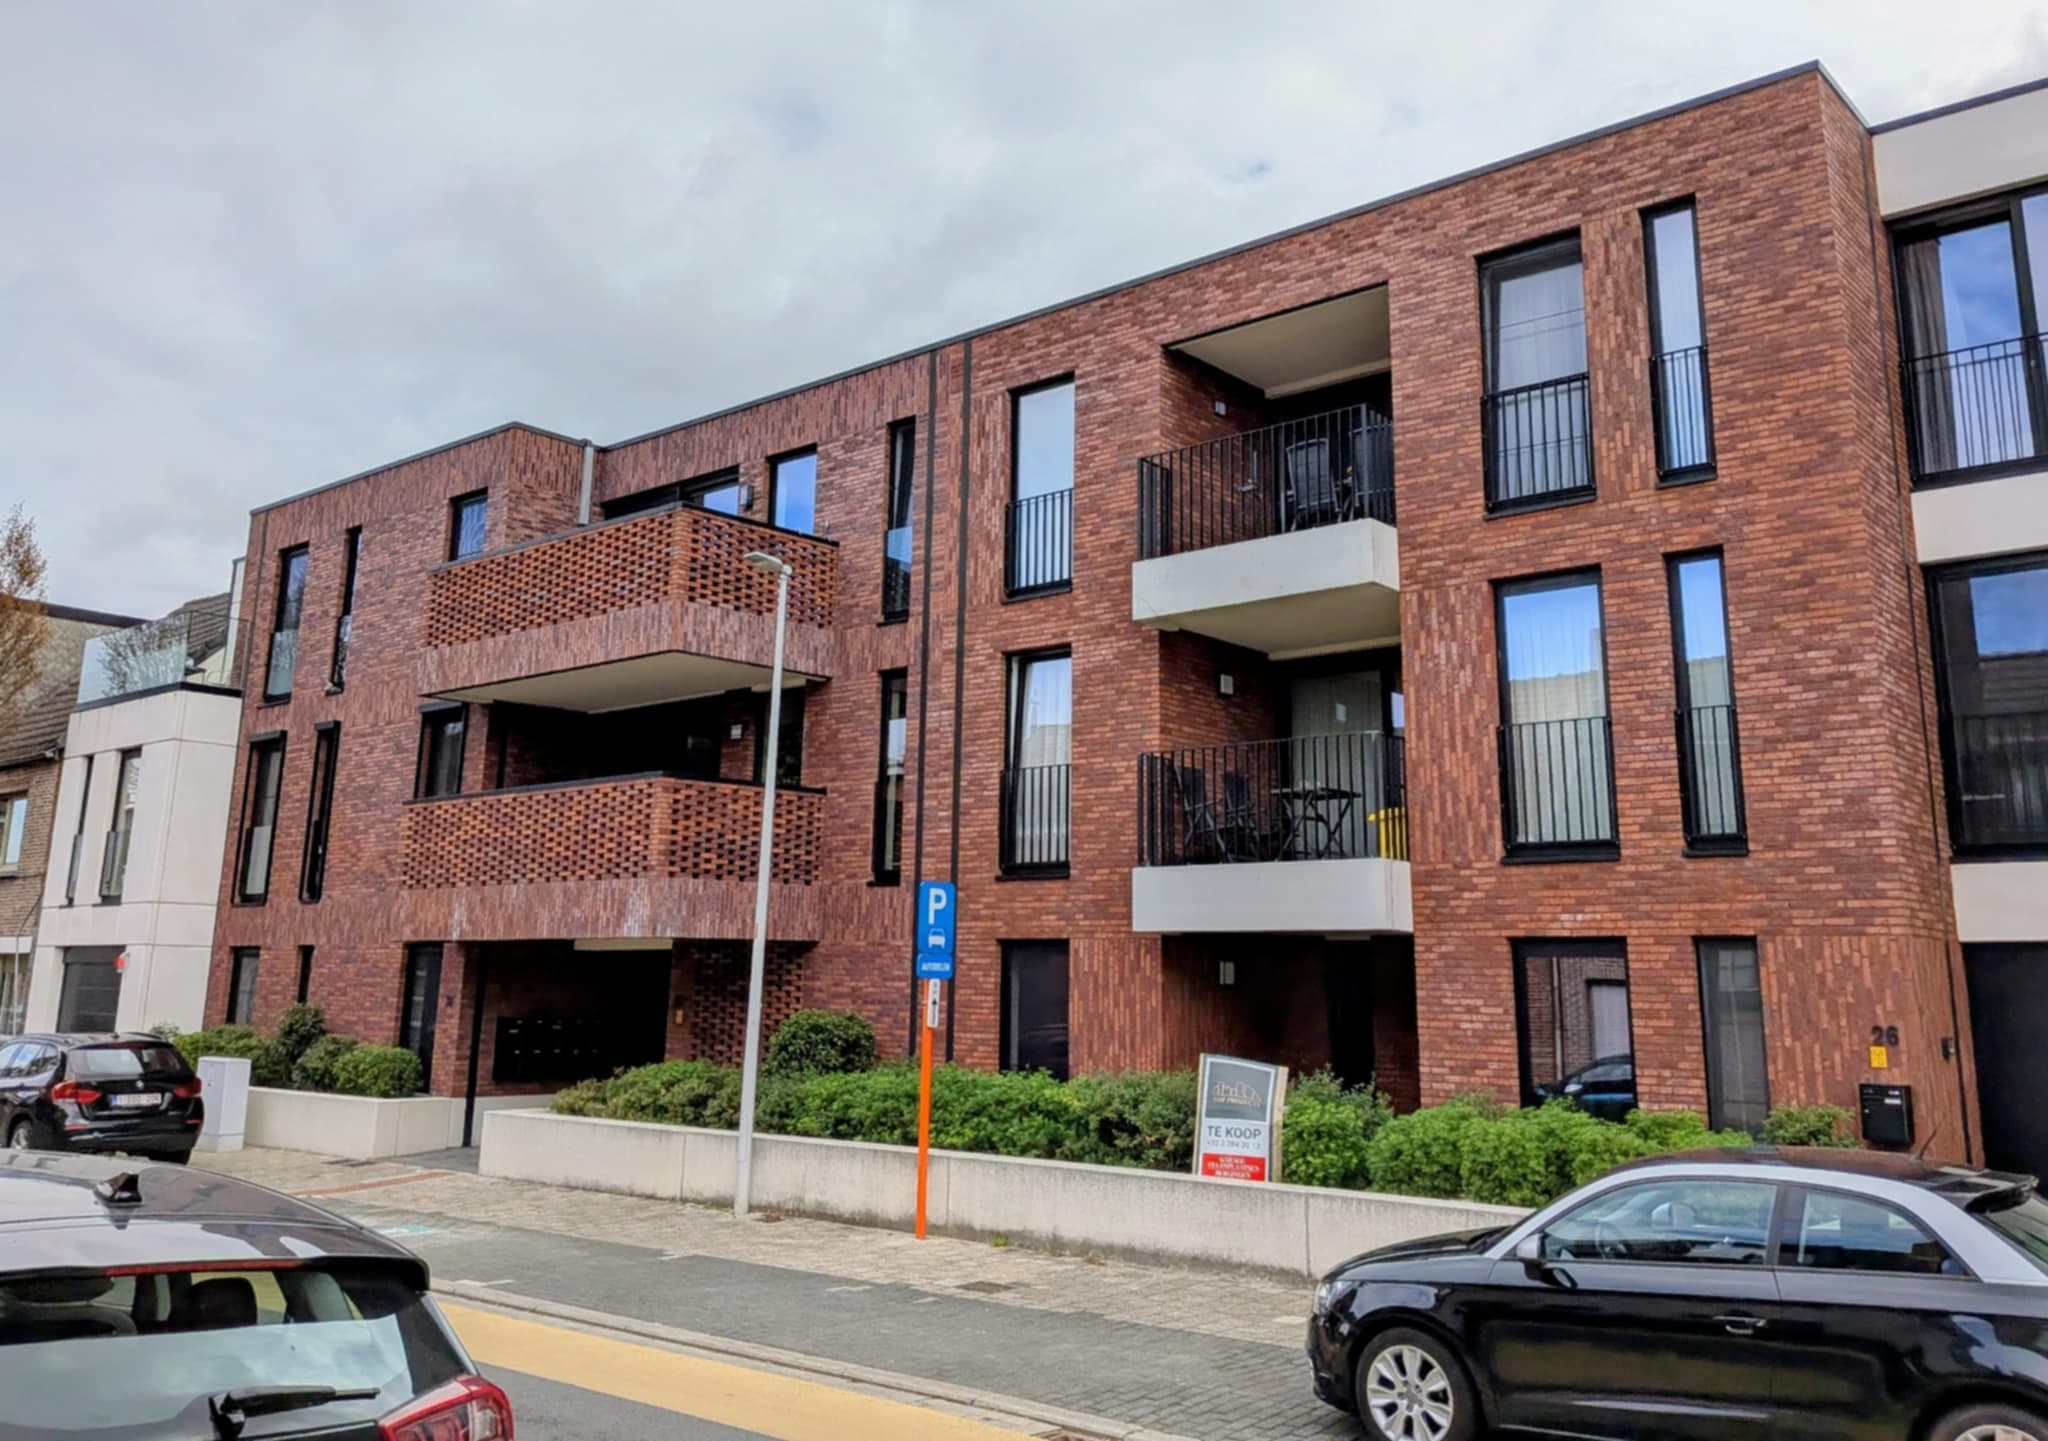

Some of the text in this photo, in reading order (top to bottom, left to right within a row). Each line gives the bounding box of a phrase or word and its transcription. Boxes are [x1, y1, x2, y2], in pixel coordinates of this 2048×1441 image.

[928, 888, 947, 925] P
[1872, 1025, 1899, 1046] 26
[1207, 1125, 1262, 1140] TE KOOP
